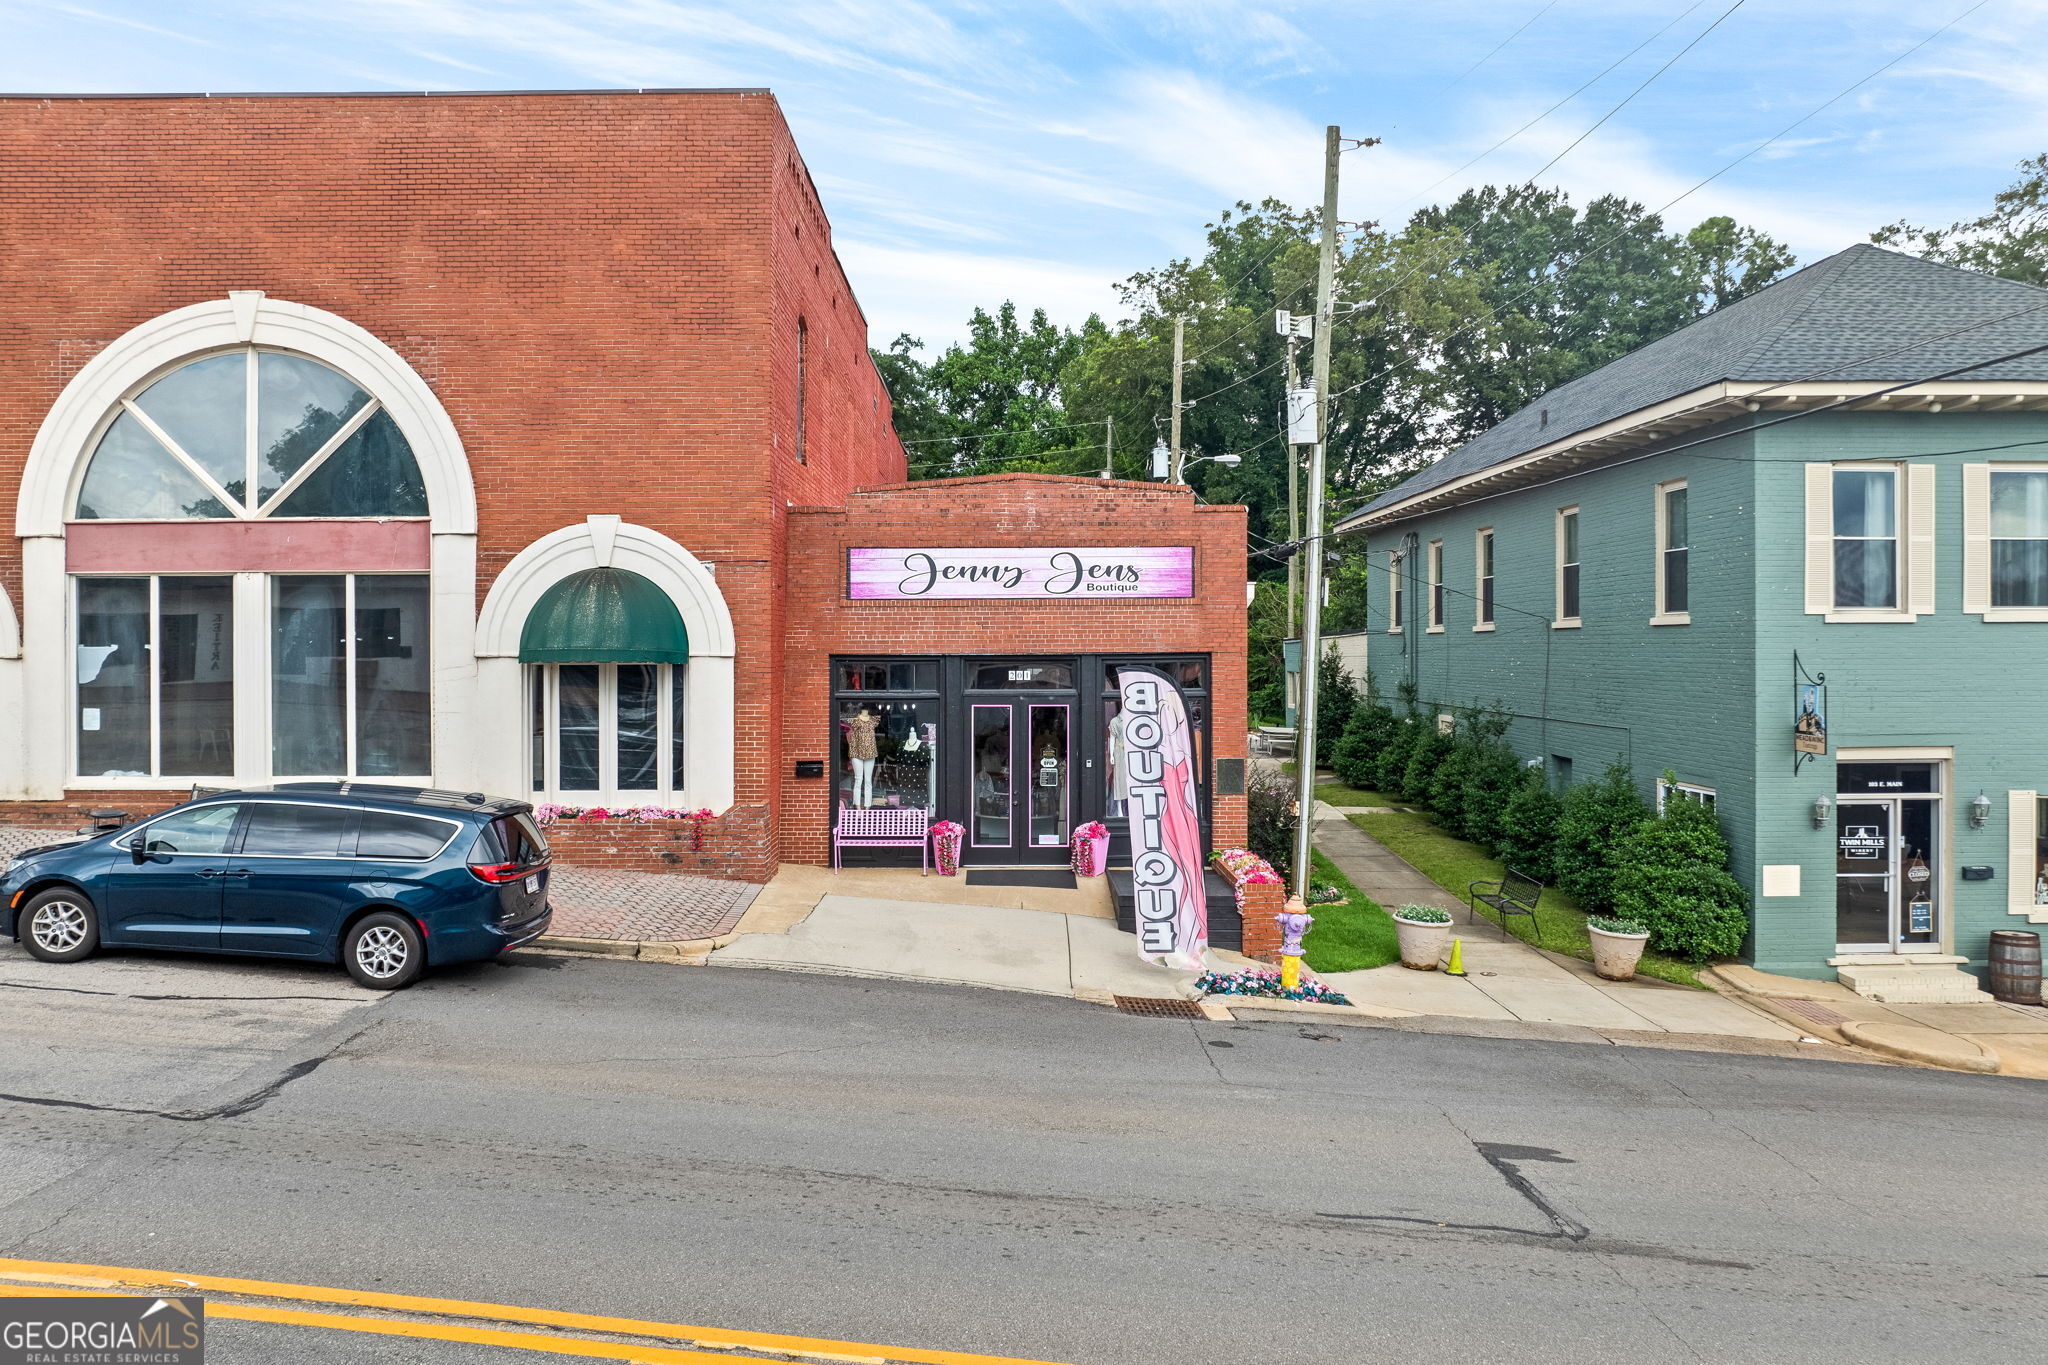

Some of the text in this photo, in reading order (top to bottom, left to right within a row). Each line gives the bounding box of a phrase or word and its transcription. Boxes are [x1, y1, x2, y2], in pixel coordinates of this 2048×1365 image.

[898, 551, 1143, 595] Jenny Jens
[1086, 582, 1138, 593] Boutique
[1008, 670, 1031, 681] 201
